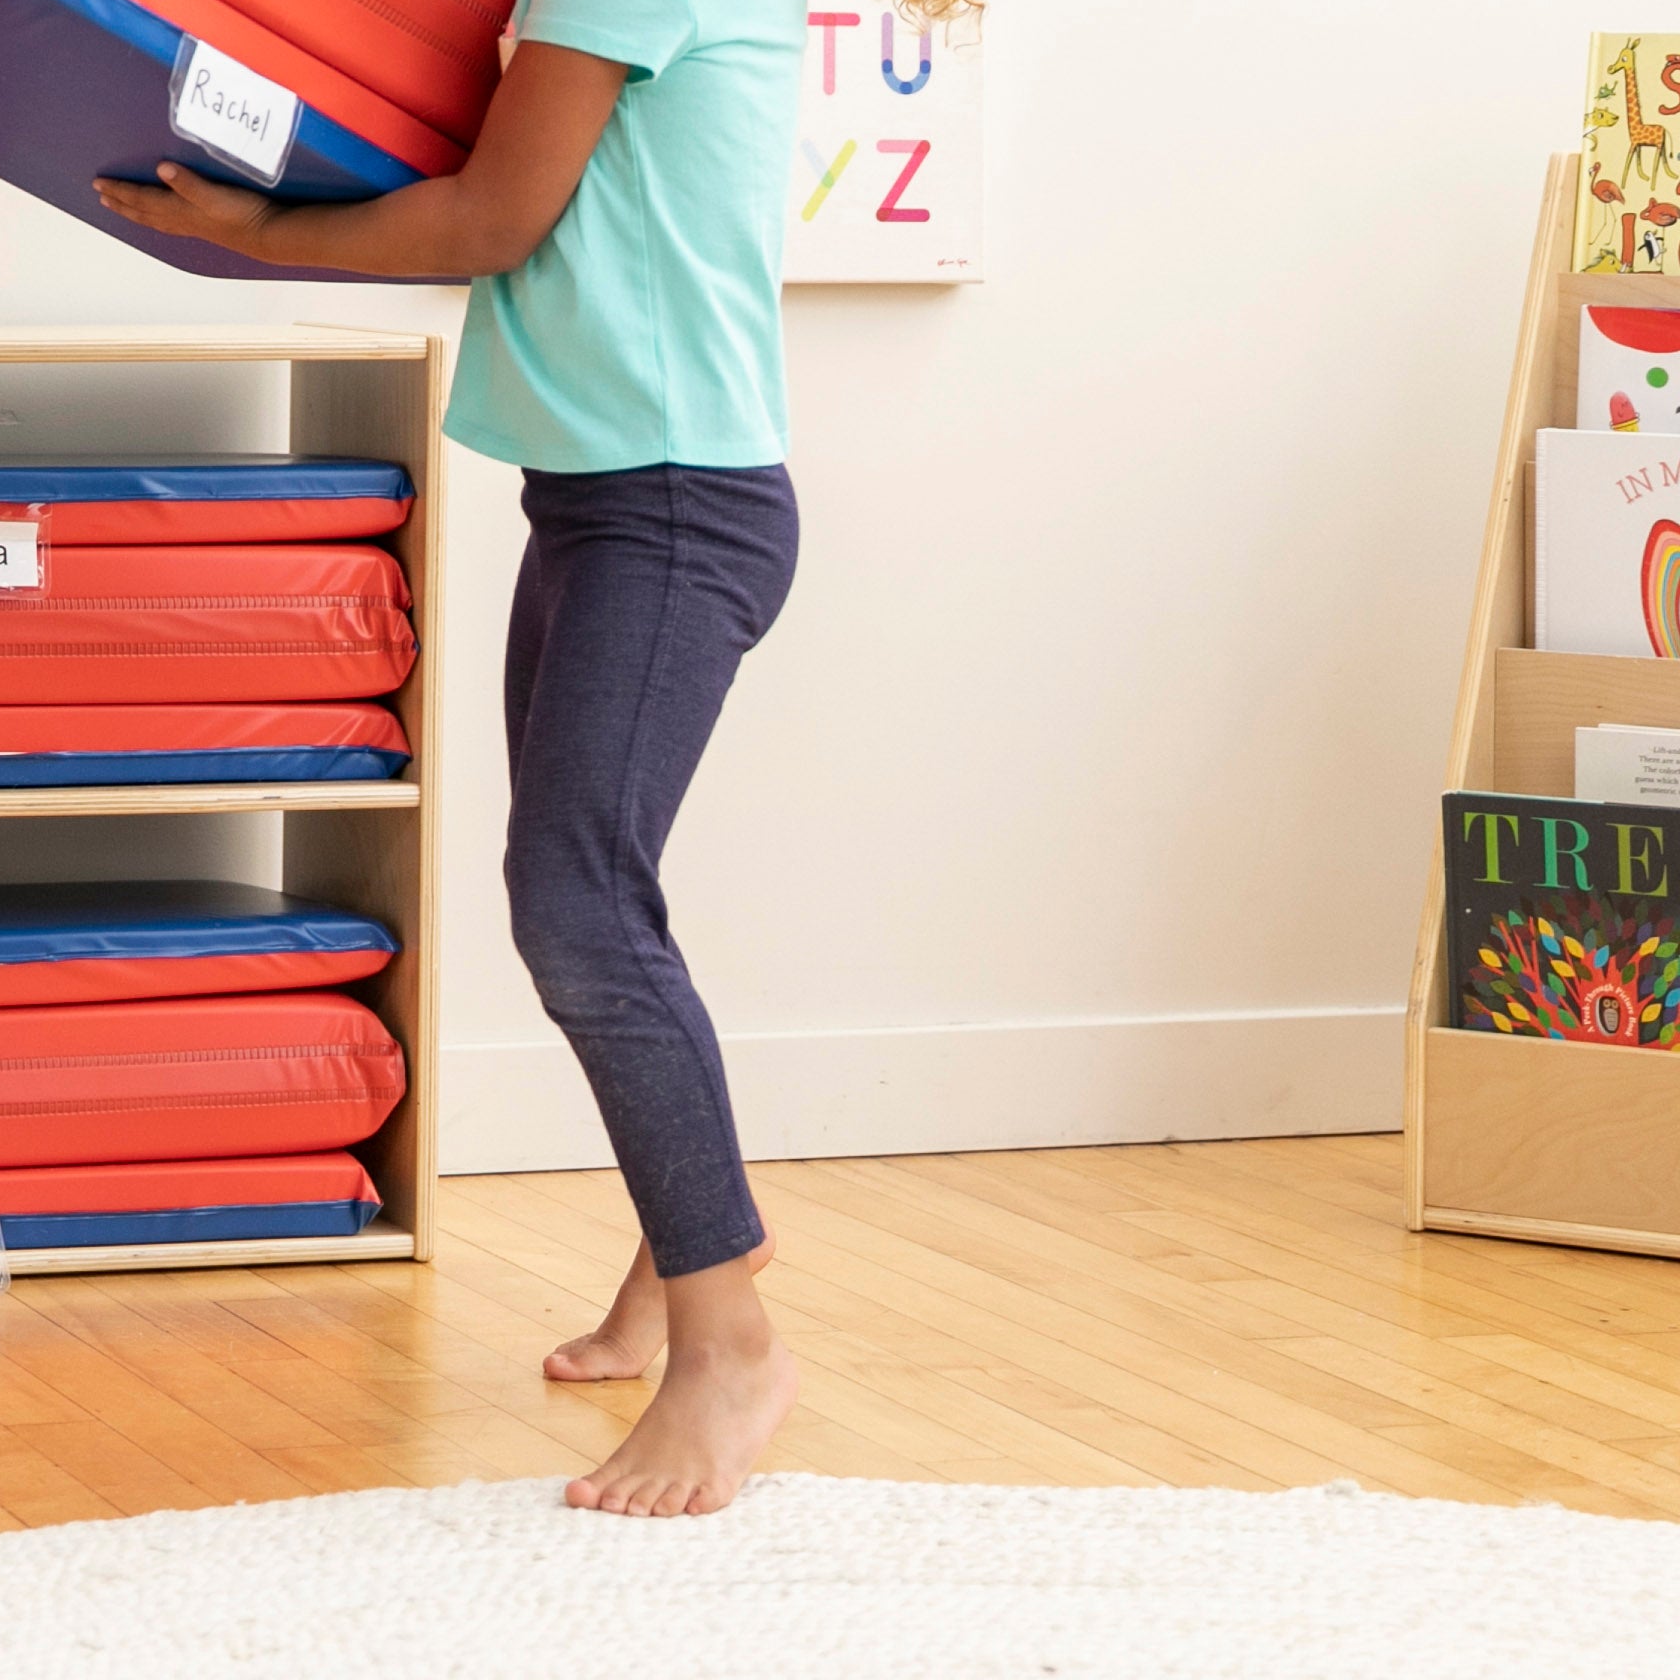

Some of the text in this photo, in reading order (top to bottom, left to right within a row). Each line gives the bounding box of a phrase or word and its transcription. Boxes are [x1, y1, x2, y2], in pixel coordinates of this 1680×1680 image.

[190, 68, 271, 142] Rachel
[1615, 467, 1654, 504] IN
[1463, 811, 1669, 898] TRE
